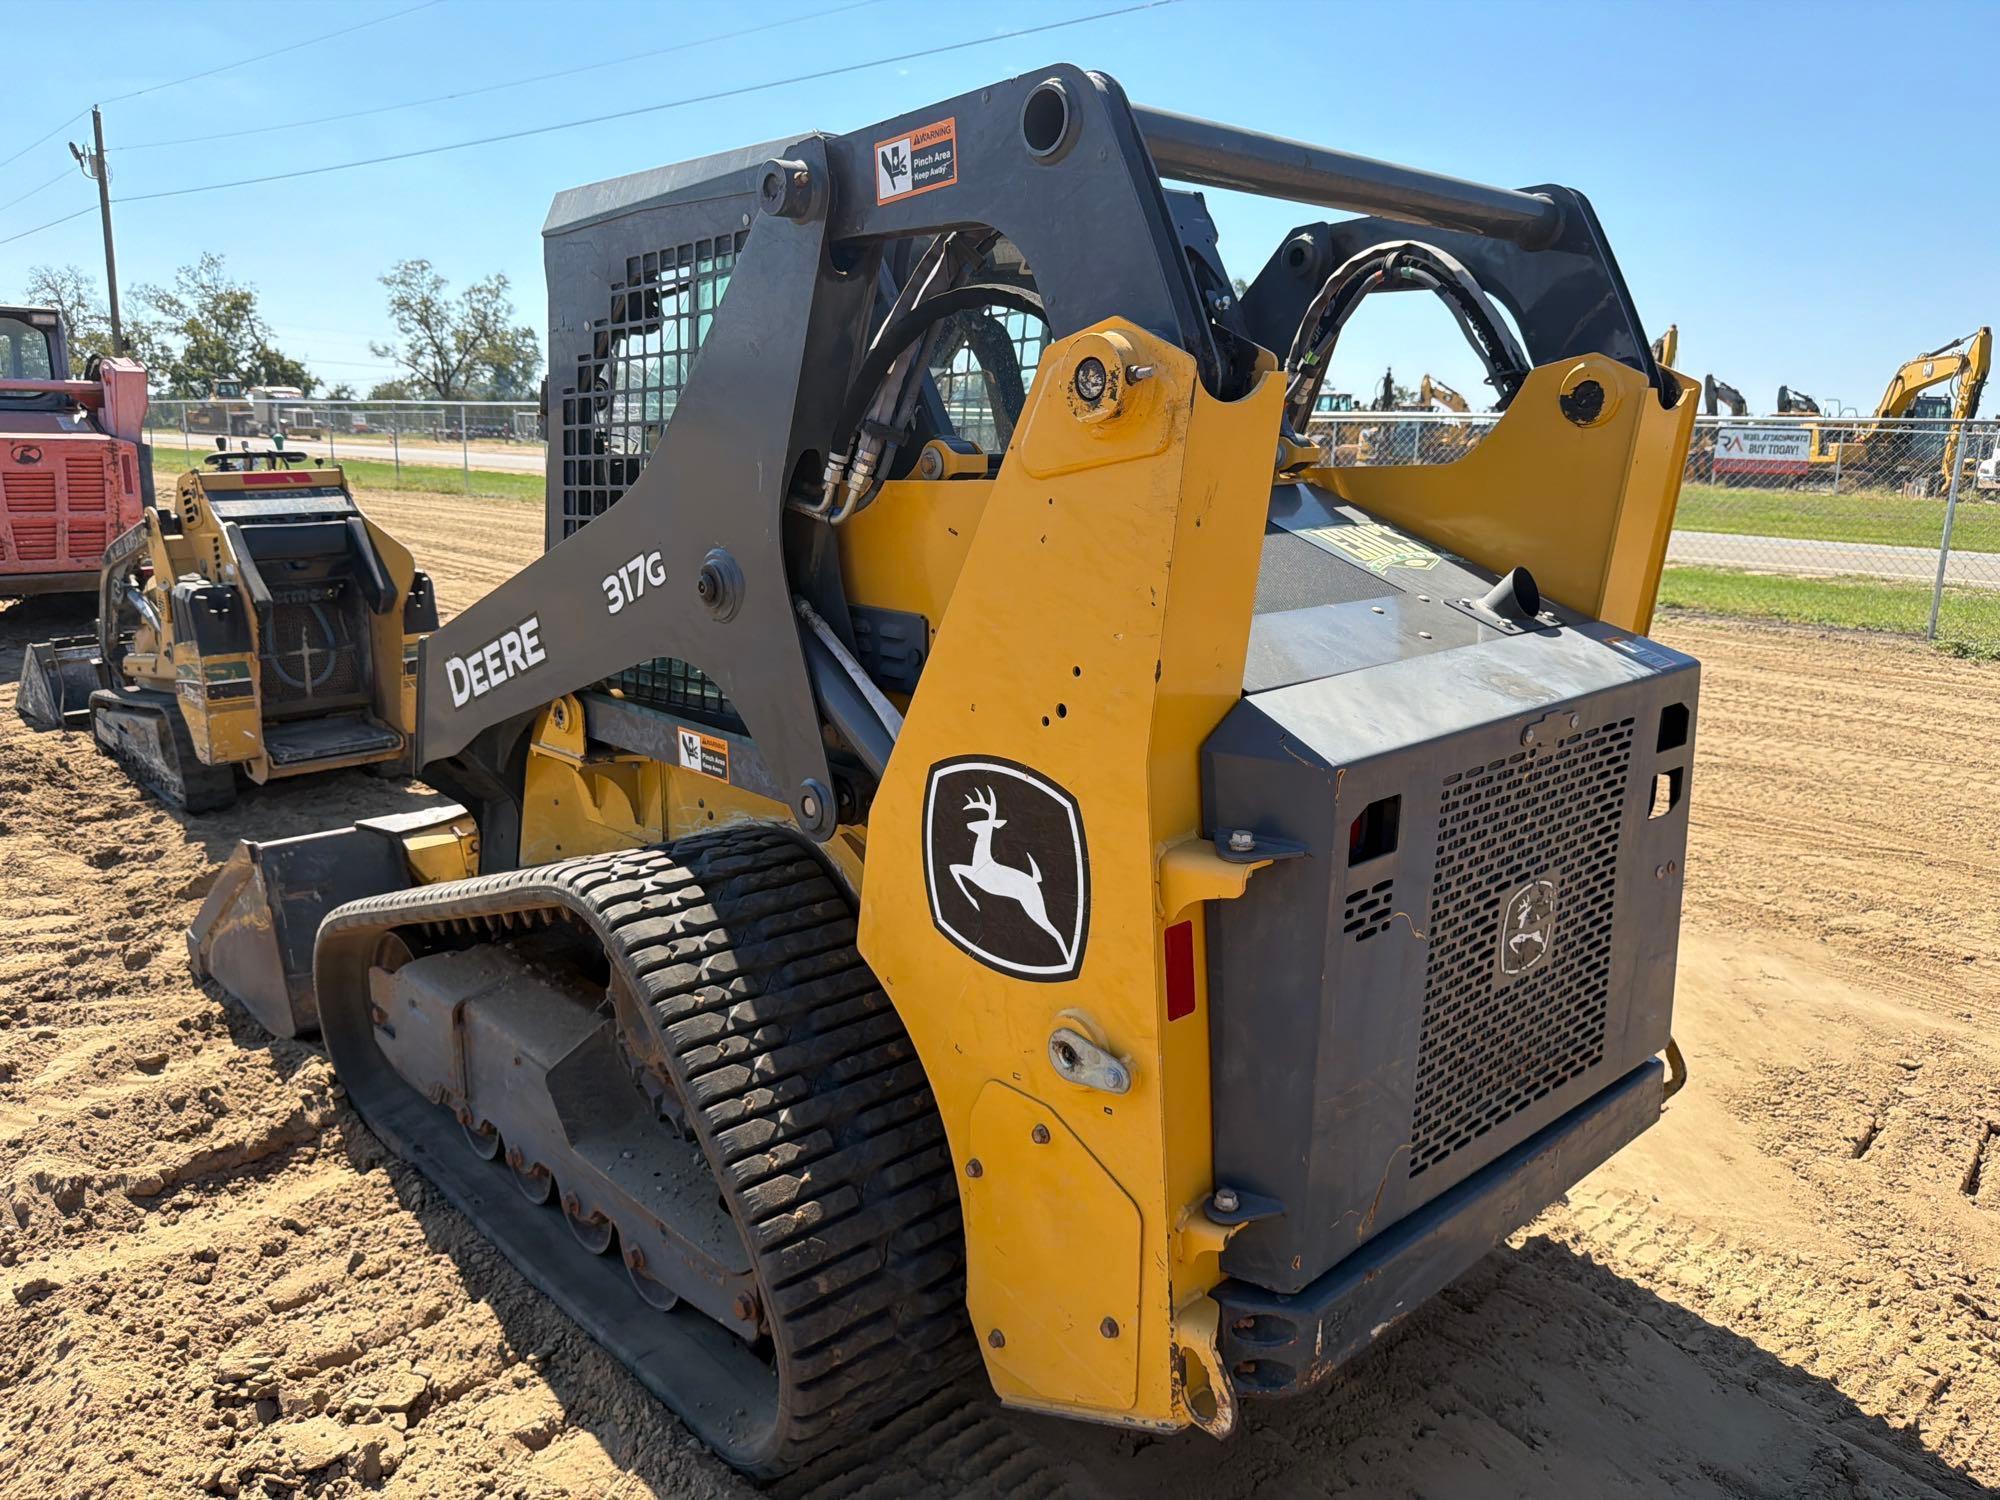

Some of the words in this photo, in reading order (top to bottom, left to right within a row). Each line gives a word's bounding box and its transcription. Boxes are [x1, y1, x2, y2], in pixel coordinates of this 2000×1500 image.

[919, 126, 951, 142] WARNING
[913, 154, 933, 168] Pinch
[934, 150, 951, 162] Area
[914, 170, 929, 181] Keep
[930, 165, 946, 177] Away
[1748, 444, 1766, 454] BUY
[1768, 444, 1799, 455] TODAY!
[602, 551, 667, 614] 317G
[445, 617, 546, 708] DEERE
